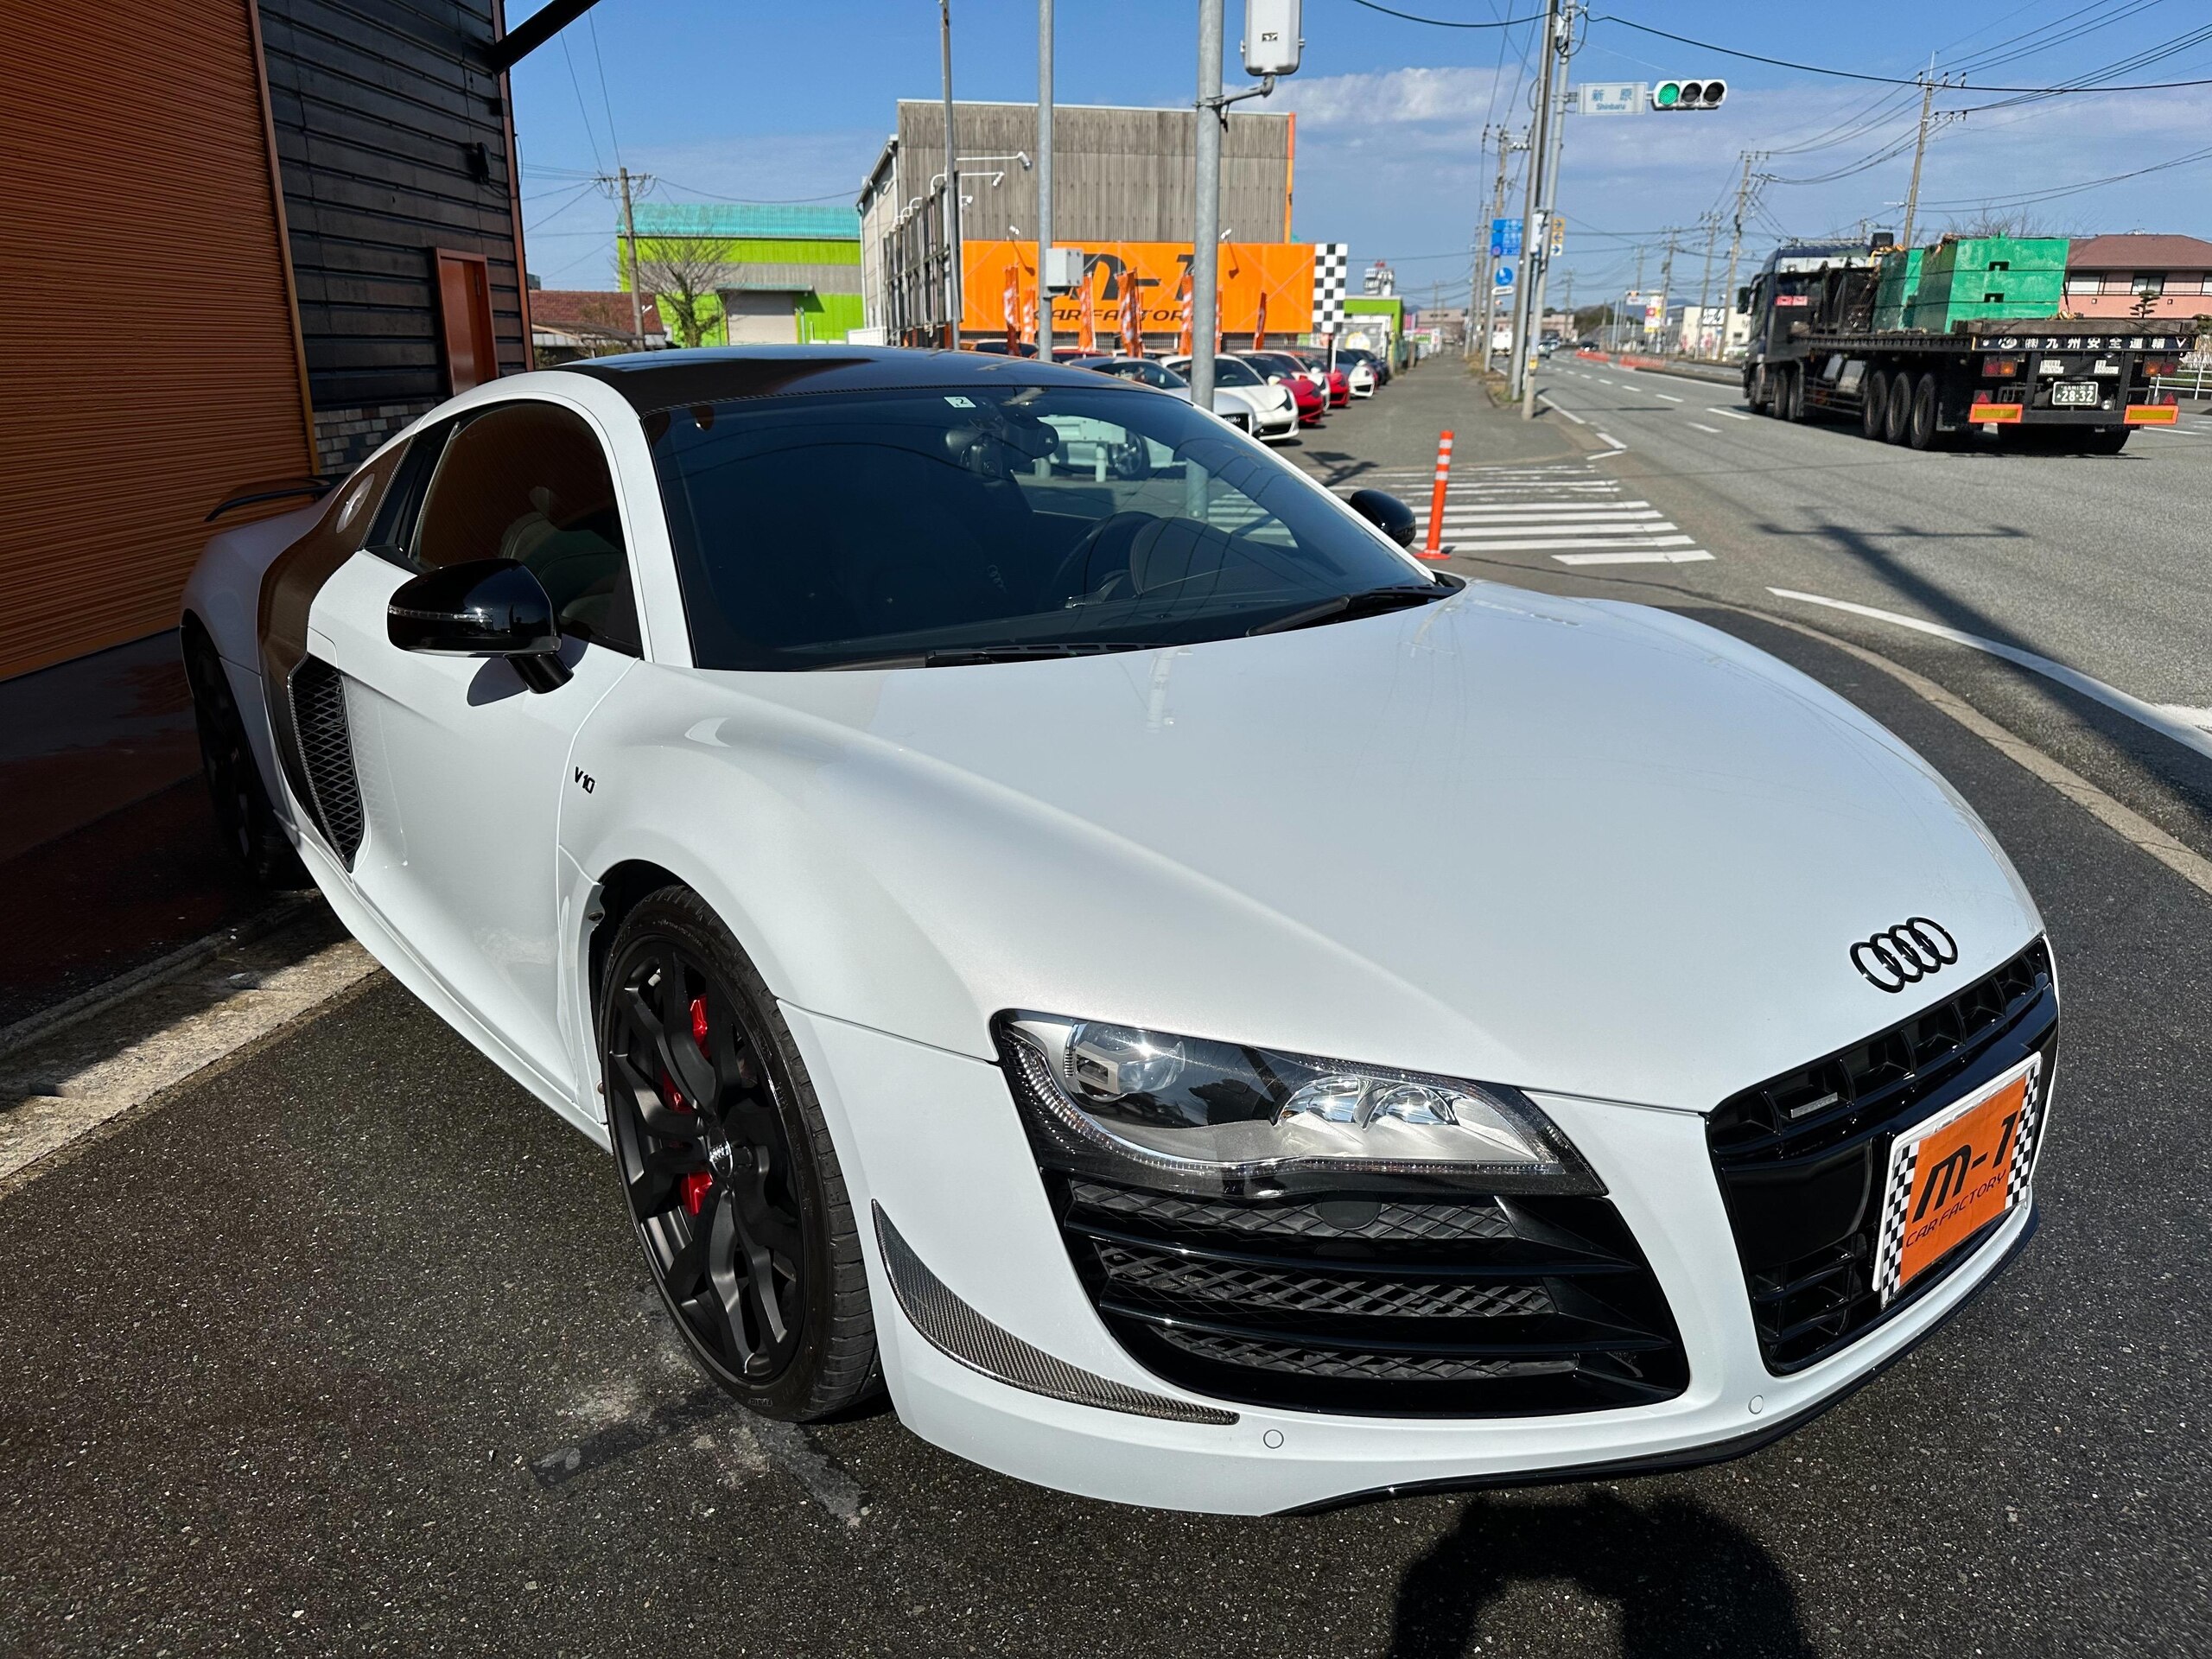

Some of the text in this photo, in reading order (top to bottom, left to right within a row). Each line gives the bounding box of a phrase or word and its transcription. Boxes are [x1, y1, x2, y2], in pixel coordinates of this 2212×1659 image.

[575, 766, 595, 794] V10
[1905, 1169, 2006, 1248] CAR FACTORY
